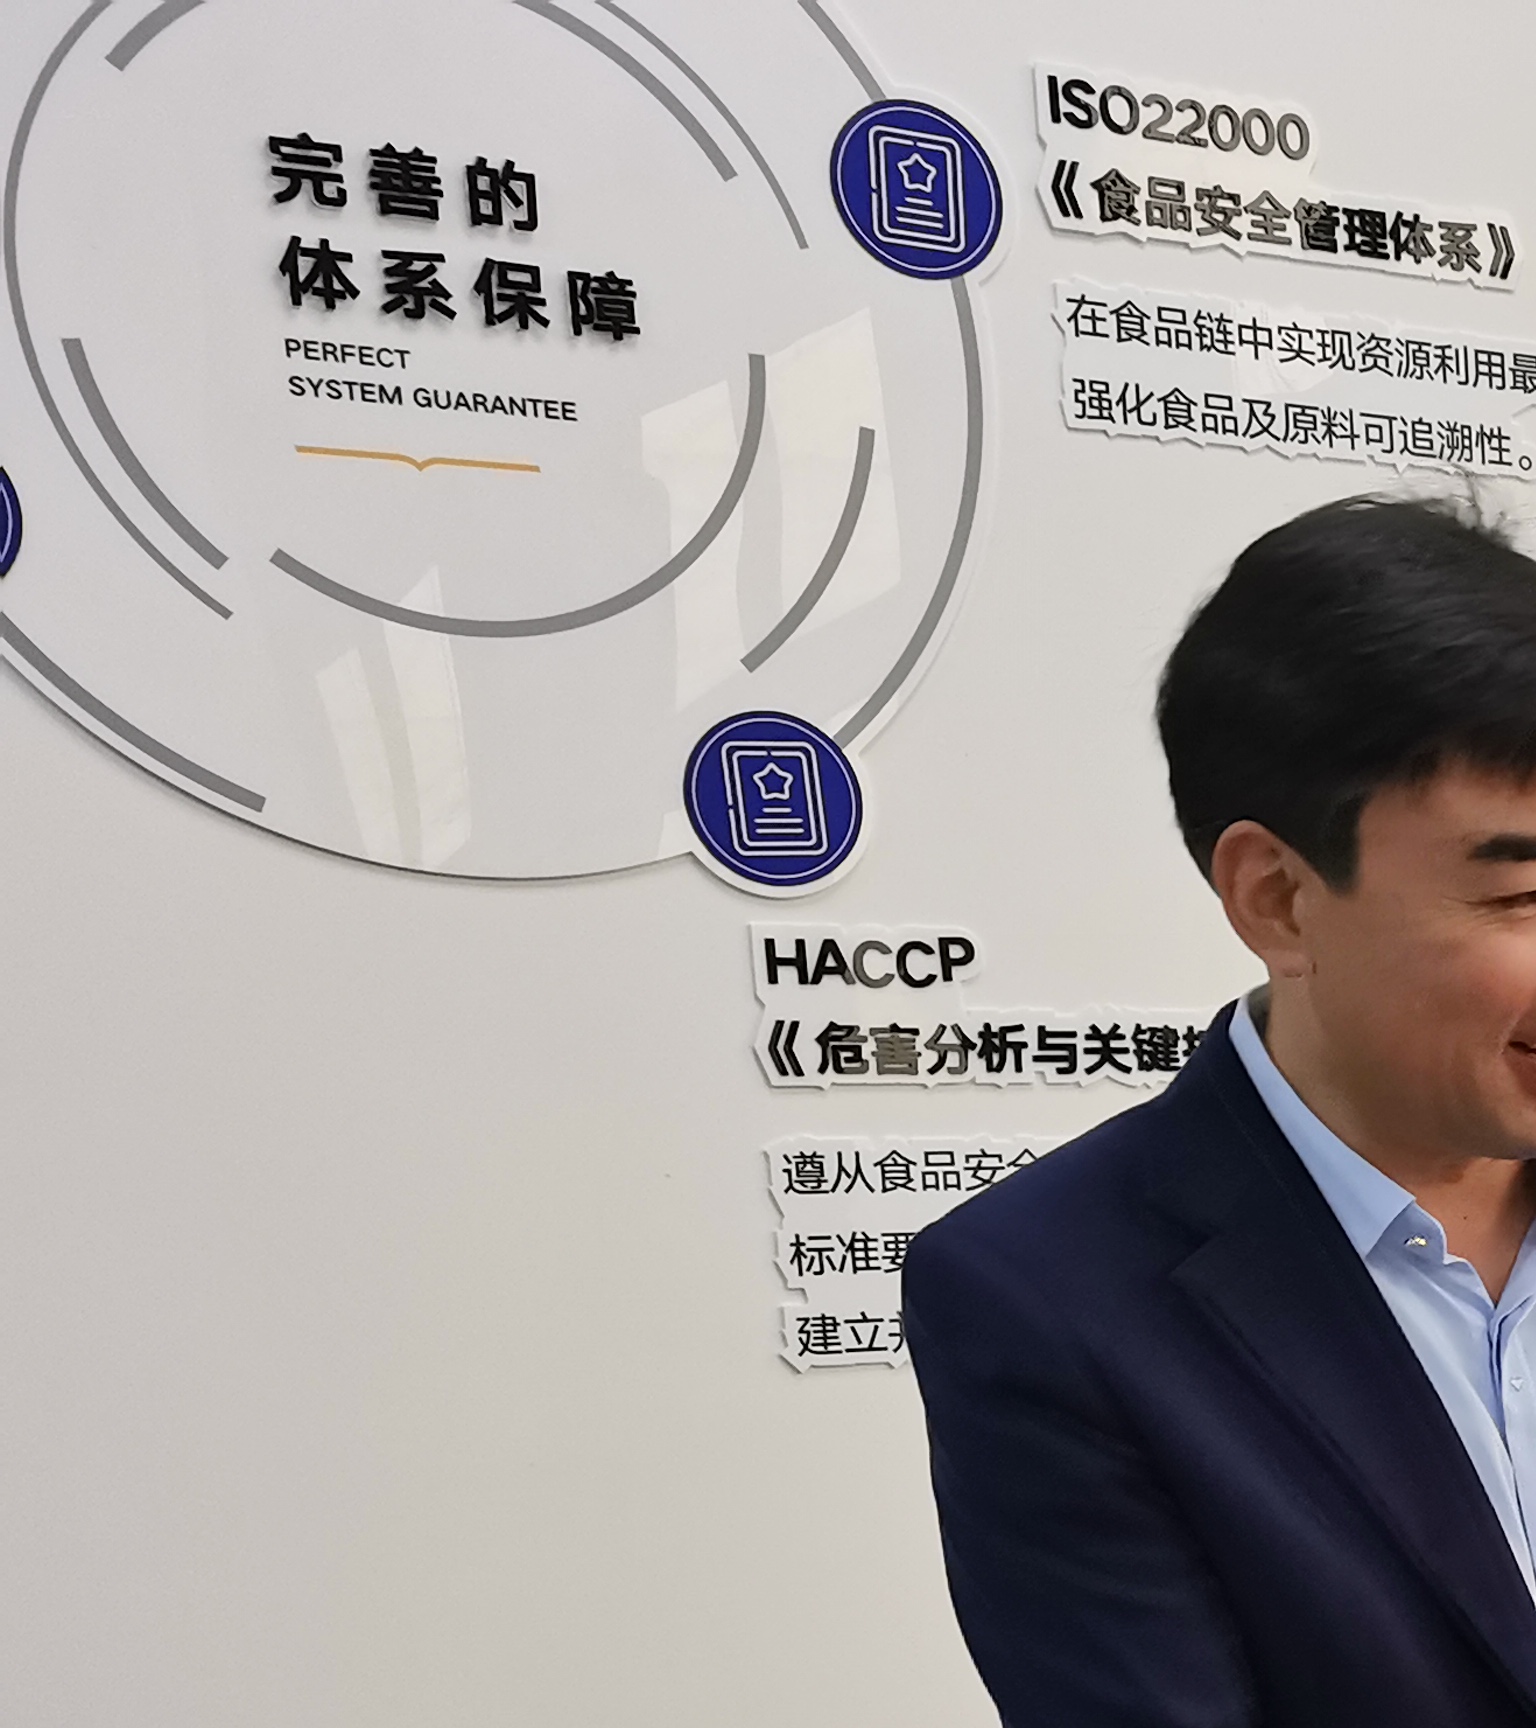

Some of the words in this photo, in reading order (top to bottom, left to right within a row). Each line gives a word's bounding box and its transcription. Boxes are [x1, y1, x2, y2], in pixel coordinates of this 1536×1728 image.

[1048, 74, 1310, 163] ISO22000
[266, 132, 539, 233] 完善的
[1050, 158, 1517, 281] 《食品安全管理体系》
[279, 236, 642, 342] 体系保障
[284, 338, 411, 371] PERFECT
[288, 374, 404, 407] SYSTEM
[412, 388, 579, 423] GUARANTEE
[763, 937, 976, 989] HACCP
[781, 1147, 1037, 1196] 遵从食品安
